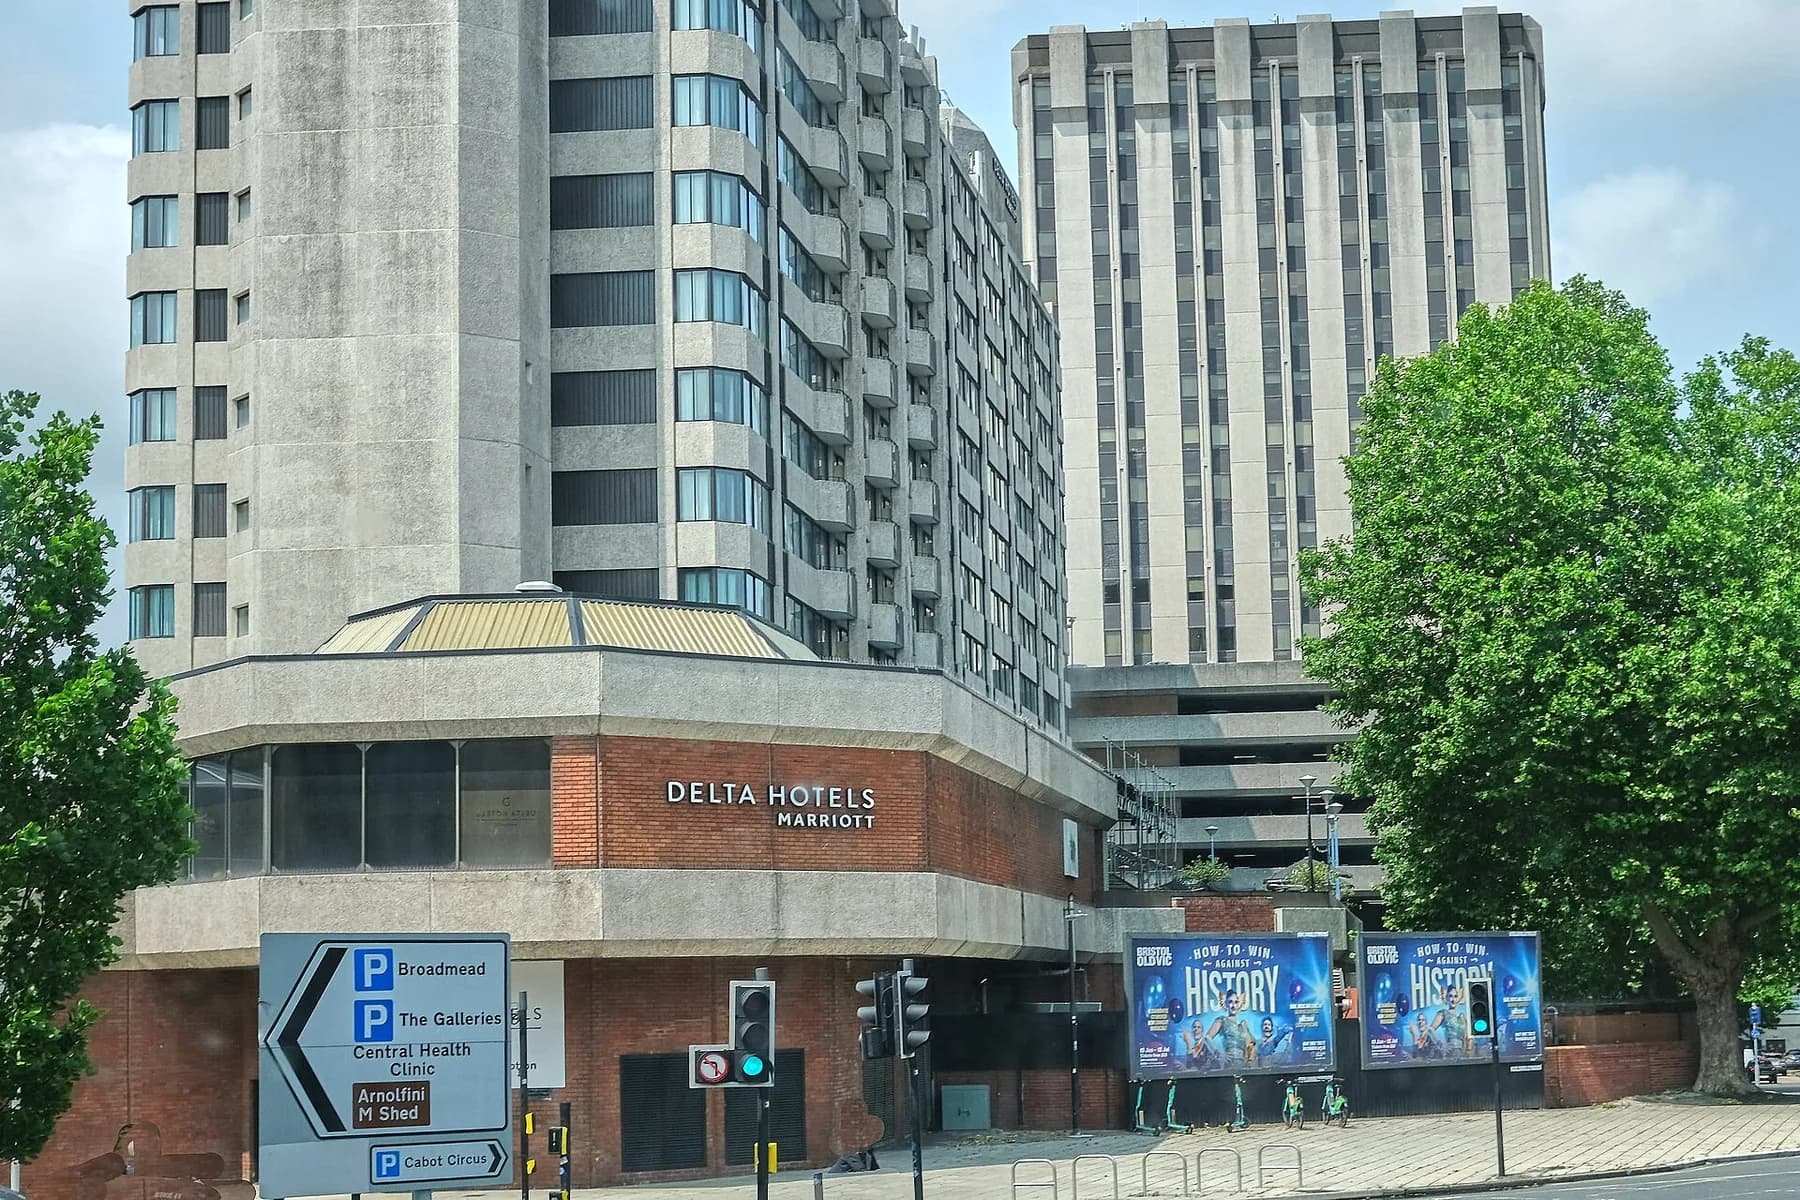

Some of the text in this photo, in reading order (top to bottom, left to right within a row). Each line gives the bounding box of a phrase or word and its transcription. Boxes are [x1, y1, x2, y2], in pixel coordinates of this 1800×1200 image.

[667, 781, 875, 809] DELTA HOTELS
[778, 813, 875, 829] MARRIOTT
[1137, 946, 1172, 956] BRISTOL
[1193, 944, 1271, 960] HOW TO WIN
[1417, 943, 1486, 957] HOW TO WIN
[1215, 959, 1249, 969] AGAINST
[1436, 956, 1467, 965] AGAINST
[363, 953, 486, 987] P Broadmead
[363, 1004, 388, 1039] P
[399, 1012, 428, 1027] The
[434, 1011, 502, 1026] Galleries
[353, 1042, 471, 1059] Central Health
[390, 1062, 436, 1076] Clinic
[358, 1087, 425, 1103] Arnolfini
[359, 1105, 419, 1122] M Shed
[381, 1154, 487, 1175] P Cabot Circus
